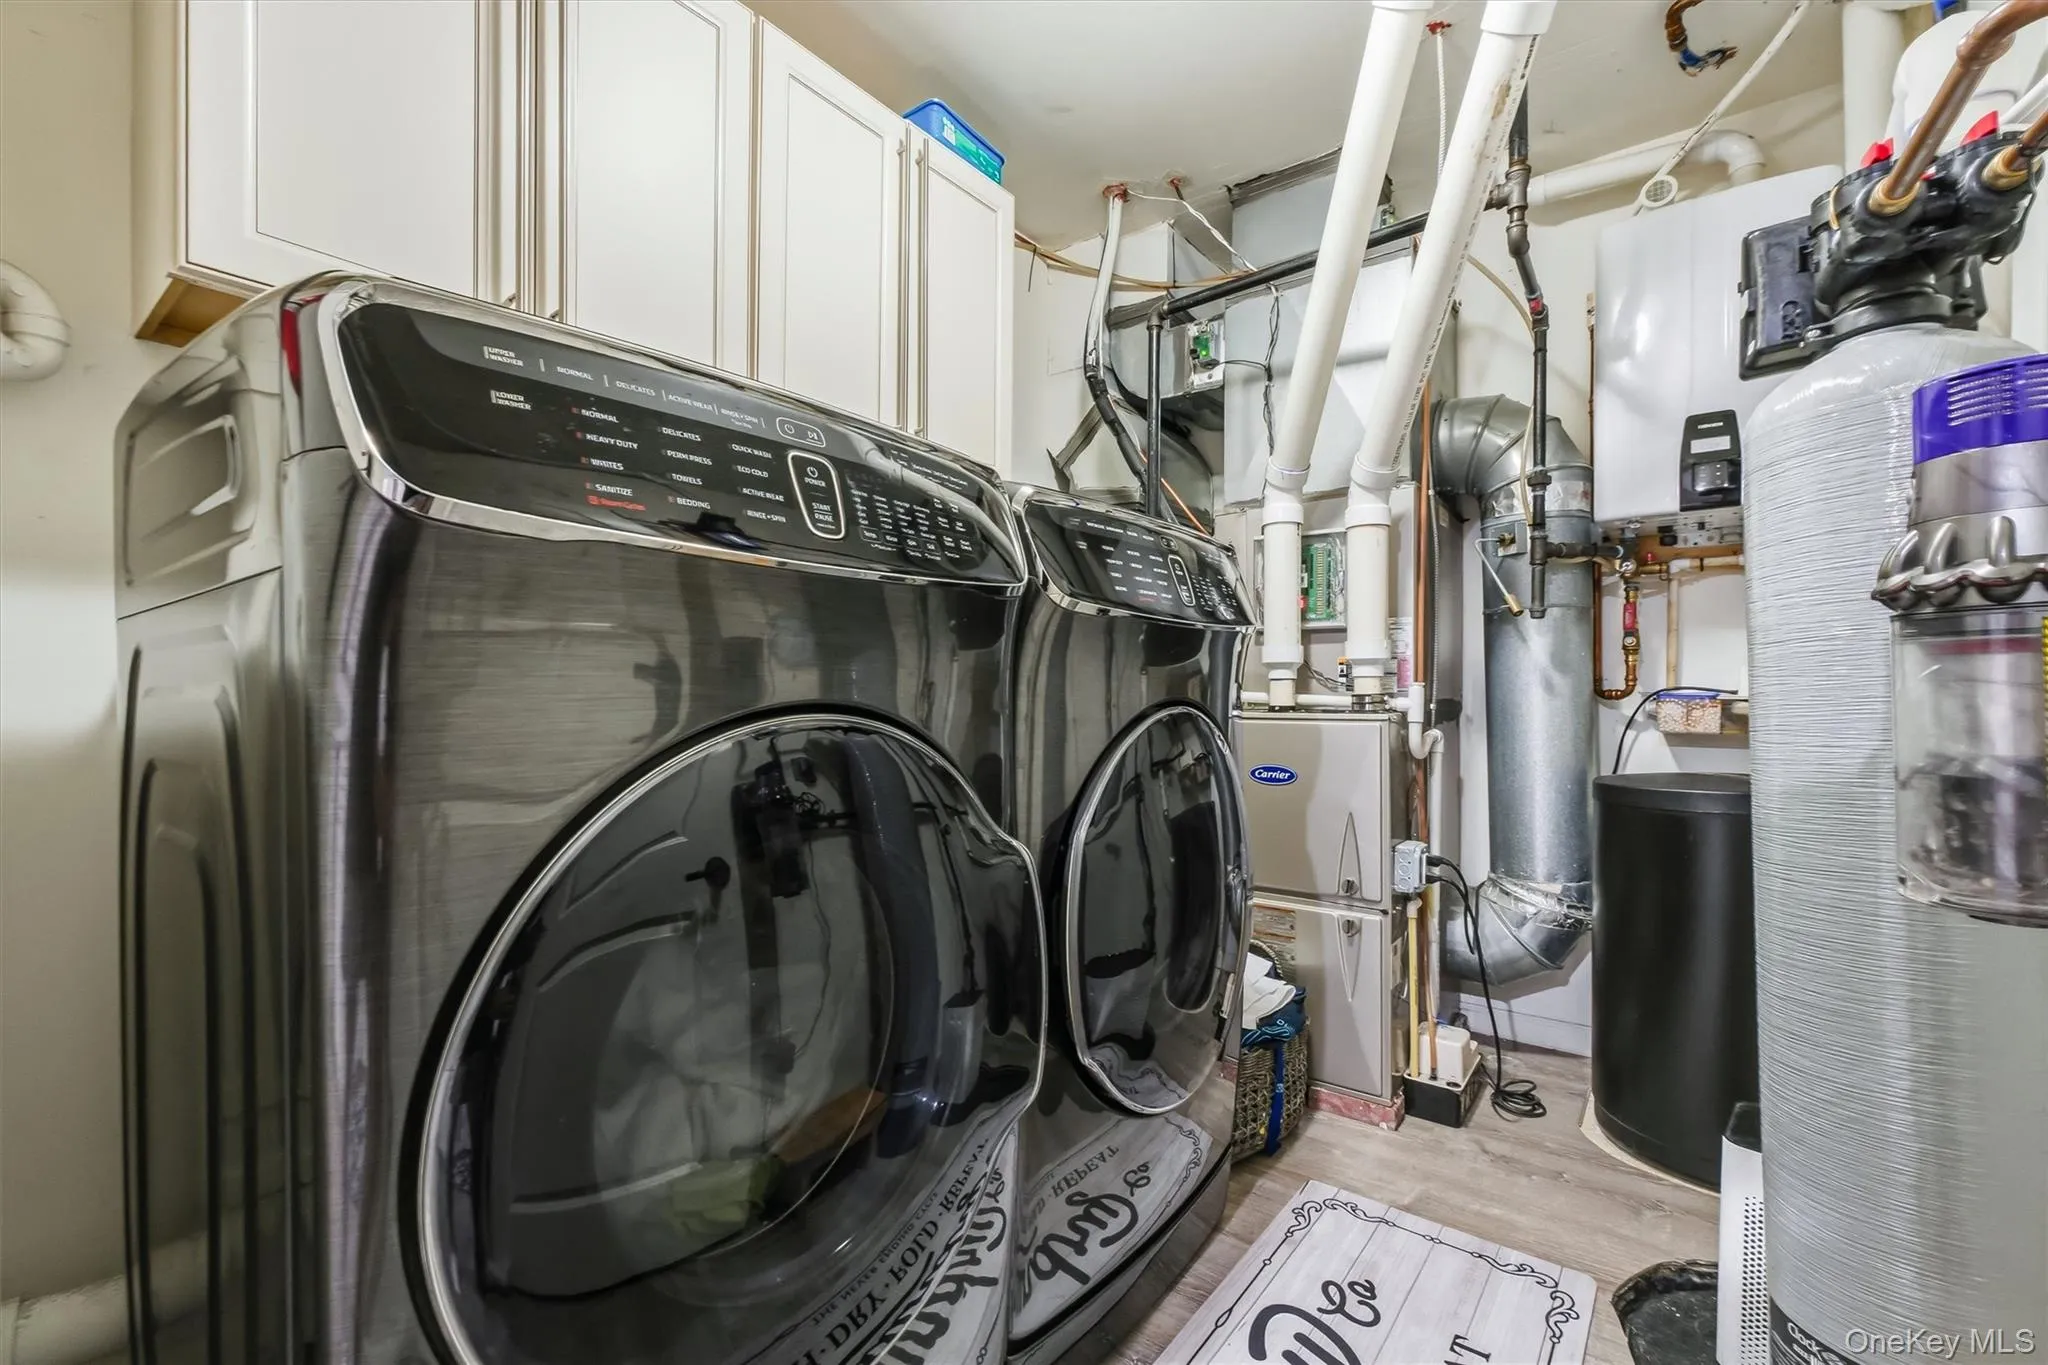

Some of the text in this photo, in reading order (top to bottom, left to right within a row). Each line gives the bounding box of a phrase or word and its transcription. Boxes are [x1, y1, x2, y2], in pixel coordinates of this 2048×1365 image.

[557, 366, 594, 381] NORMAL
[615, 380, 656, 396] DELICATES
[581, 409, 619, 423] NORMAL
[662, 427, 702, 441] DELICATES
[586, 433, 638, 450] HEAVY DUTY
[731, 444, 752, 454] QUICK
[689, 454, 713, 466] PRESS
[671, 473, 703, 485] TOWELS
[804, 477, 826, 487] POWER
[595, 484, 633, 496] SANITIZE
[676, 497, 711, 509] BEDDING
[812, 502, 831, 511] START
[814, 513, 834, 522] PAUSE
[1255, 769, 1291, 780] Carrier
